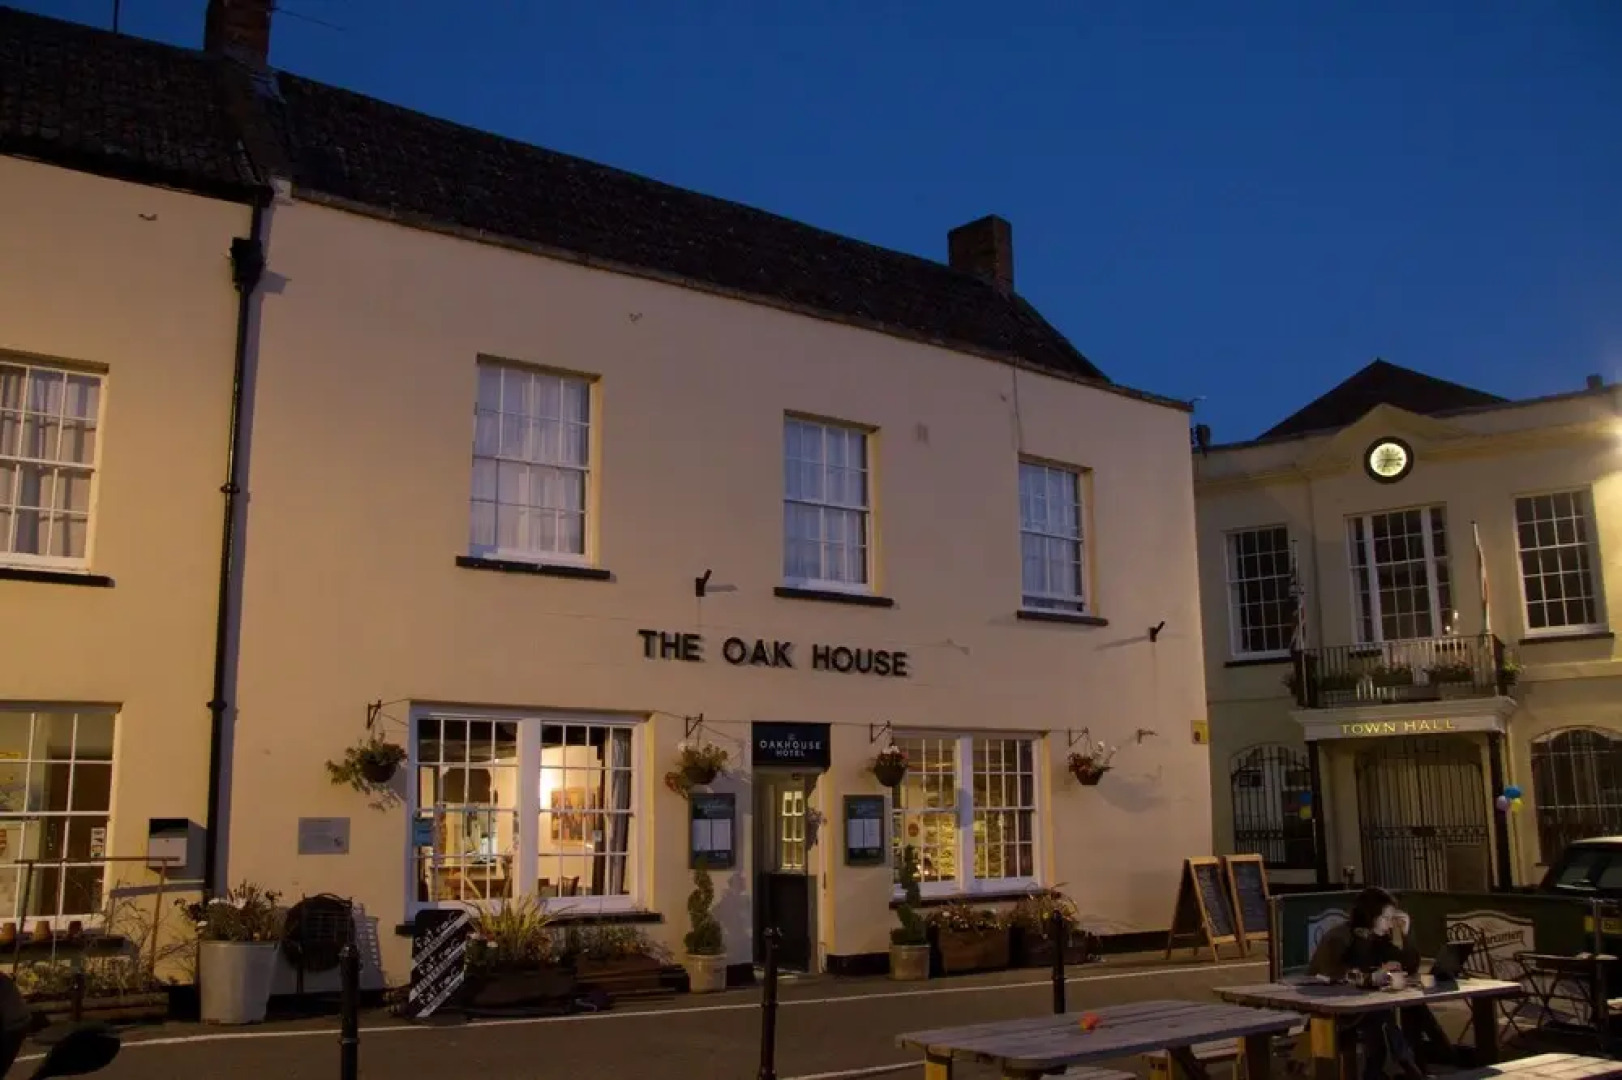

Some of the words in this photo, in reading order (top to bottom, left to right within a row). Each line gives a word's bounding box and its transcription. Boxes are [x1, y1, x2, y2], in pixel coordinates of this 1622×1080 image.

[638, 629, 701, 661] THE
[722, 637, 794, 668] OAK
[812, 644, 907, 676] HOUSE
[1342, 722, 1396, 734] TOWN
[1404, 719, 1455, 731] HALL
[760, 740, 821, 750] OAKHOUSE
[776, 750, 806, 758] HOTEL
